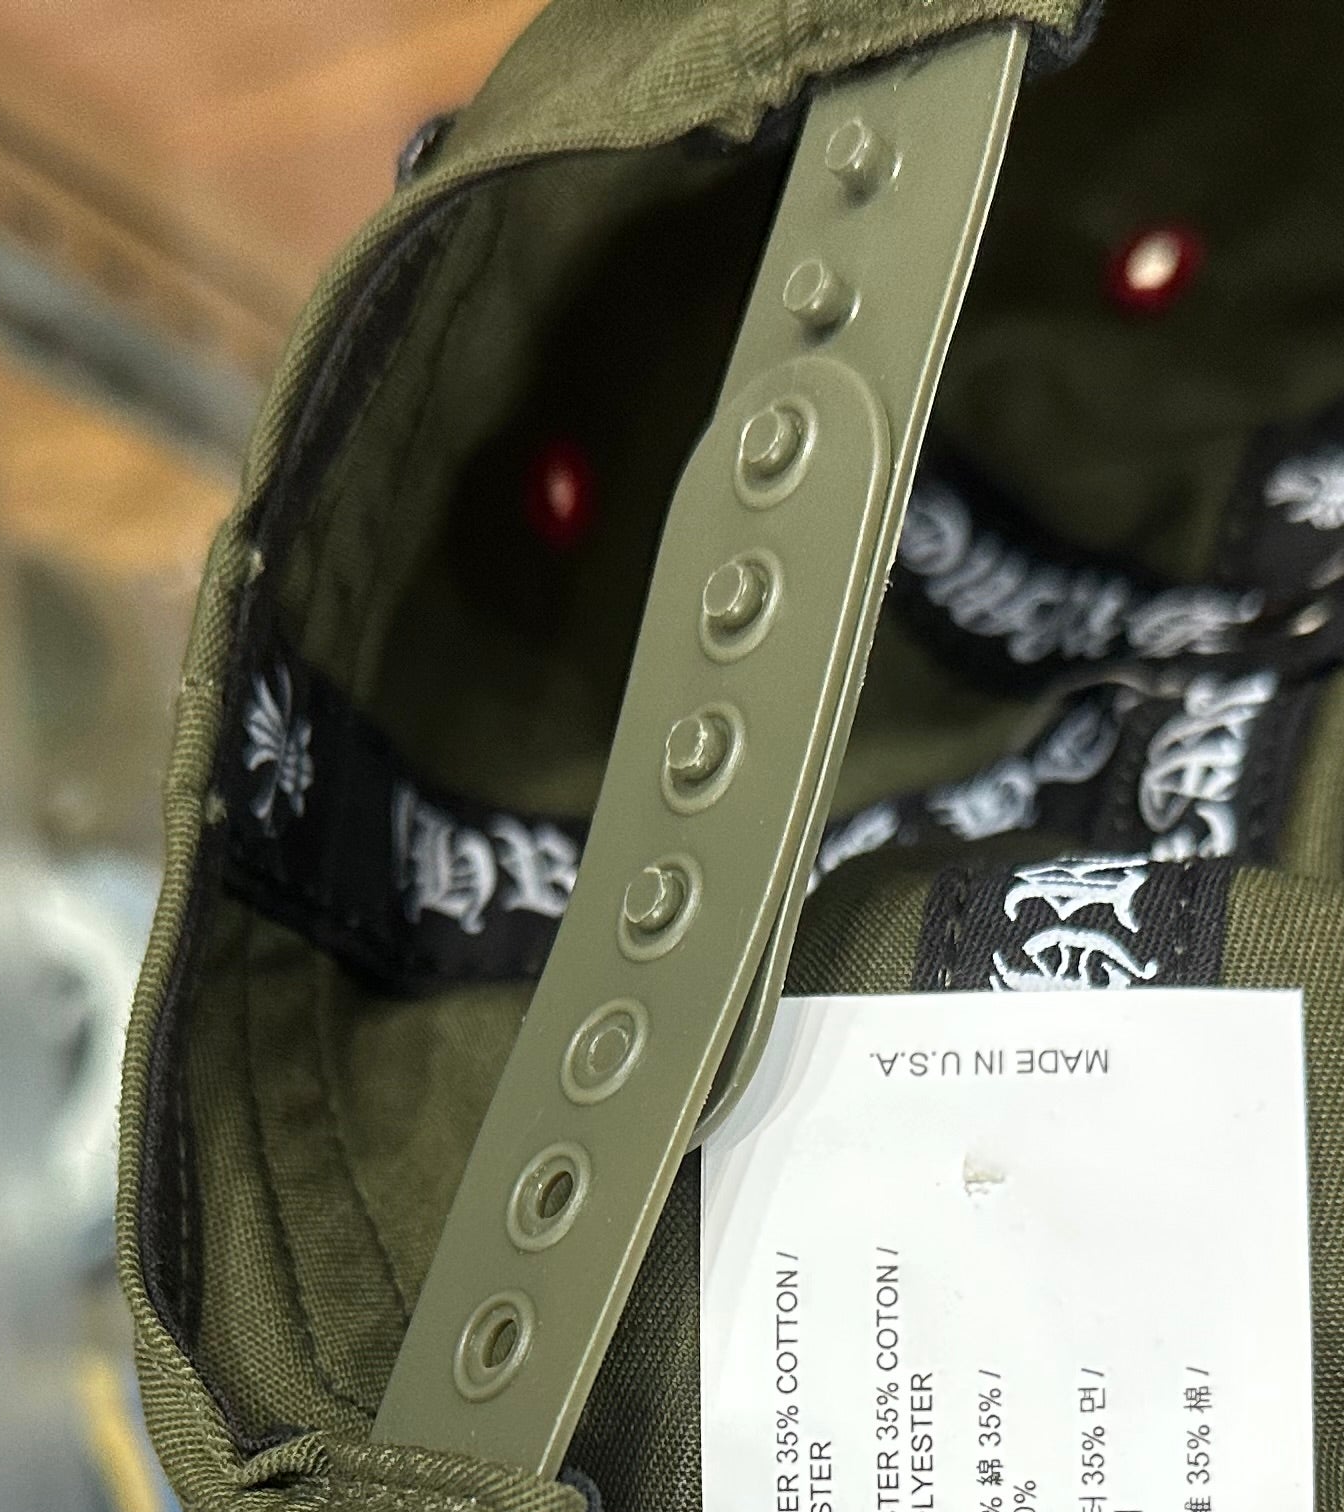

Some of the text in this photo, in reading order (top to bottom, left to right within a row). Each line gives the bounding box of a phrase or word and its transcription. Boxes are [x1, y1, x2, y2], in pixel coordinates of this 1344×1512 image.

[868, 1048, 1109, 1077] MADE IN U.S.A.
[775, 1251, 799, 1260] /
[875, 1246, 899, 1256] /
[775, 1269, 799, 1396] COTTON
[875, 1264, 899, 1373] COTON
[978, 1369, 1002, 1380] /
[1080, 1367, 1105, 1378] /
[1185, 1366, 1210, 1377] /
[875, 1382, 900, 1441] 35%
[1077, 1386, 1107, 1414] 면
[1182, 1385, 1213, 1414] 棉
[977, 1387, 1003, 1448] 35%
[775, 1404, 800, 1464] 35%
[1080, 1425, 1106, 1486] 35%
[1185, 1424, 1212, 1485] 35%
[975, 1458, 1005, 1487] 綿
